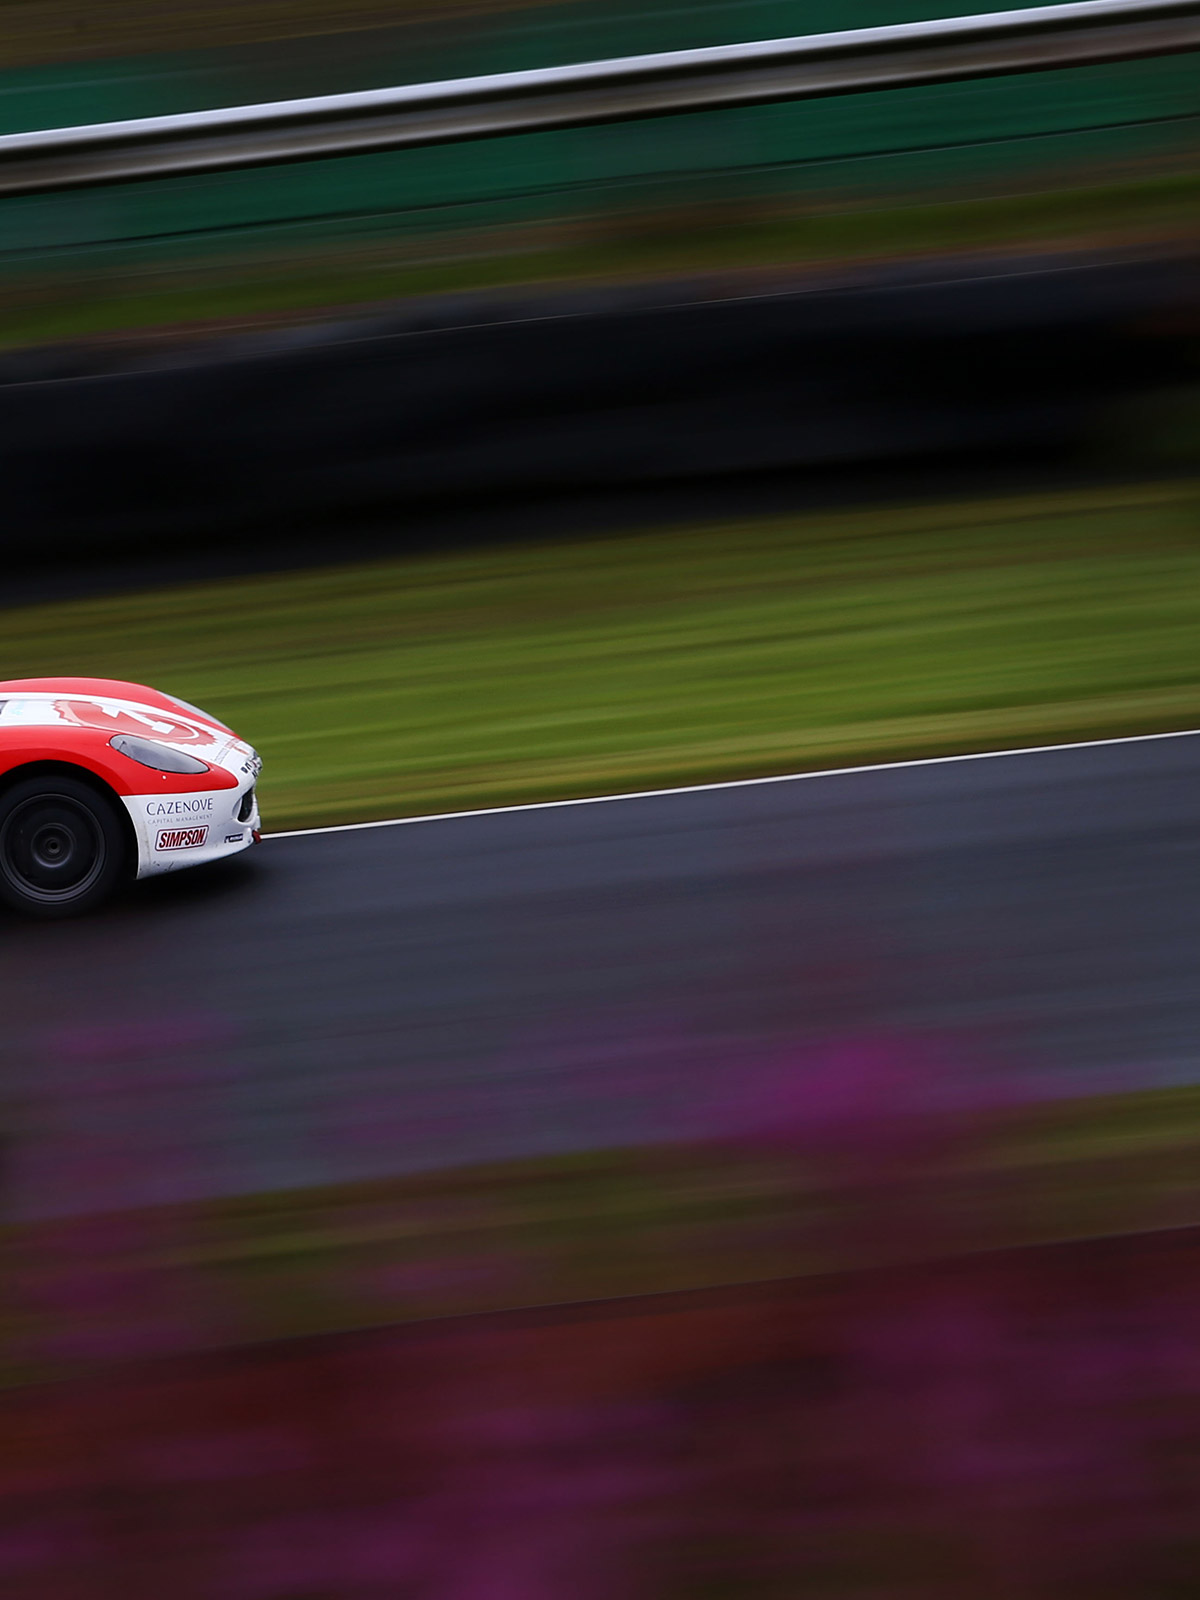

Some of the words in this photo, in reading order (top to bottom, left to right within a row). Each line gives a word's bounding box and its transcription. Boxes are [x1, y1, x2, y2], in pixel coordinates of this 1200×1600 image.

[146, 798, 214, 816] CAZENOVE
[175, 814, 214, 822] MANAGEMENT
[159, 828, 206, 848] SIMPSON
